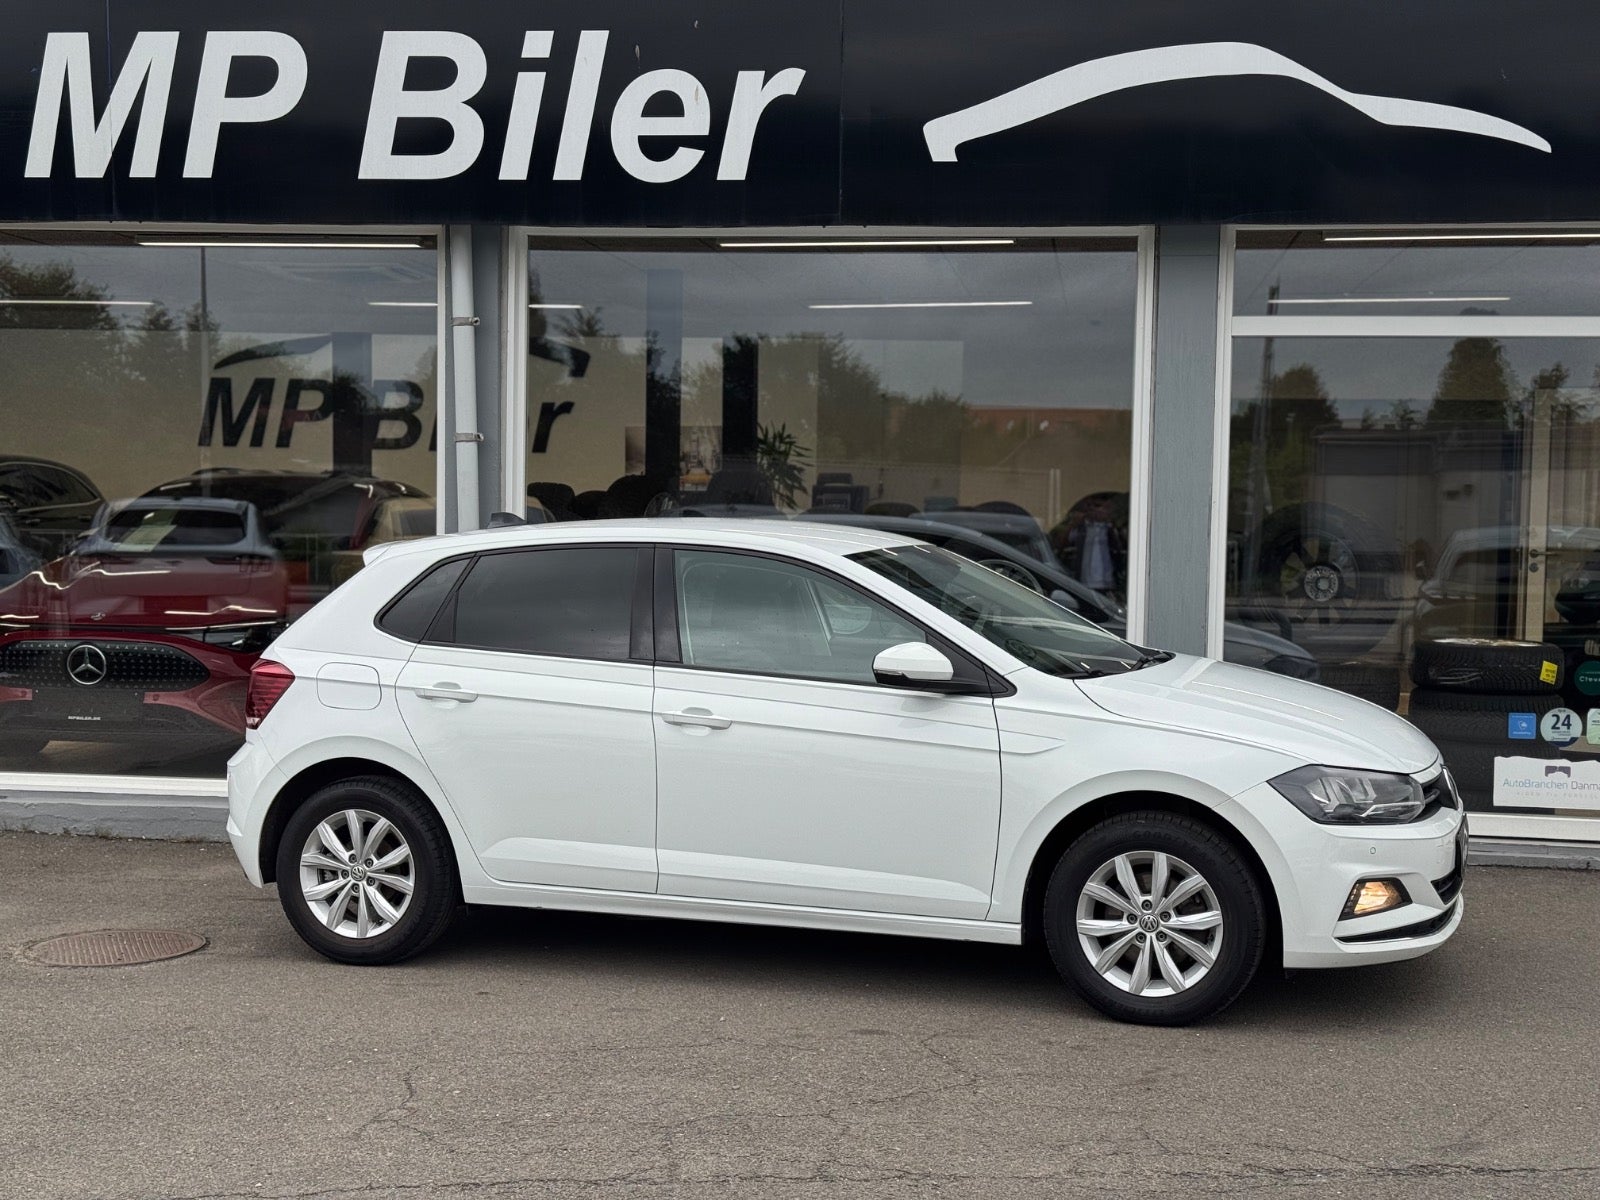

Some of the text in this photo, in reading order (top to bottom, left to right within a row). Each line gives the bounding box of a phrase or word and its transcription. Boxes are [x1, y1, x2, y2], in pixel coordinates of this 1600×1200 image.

[24, 29, 806, 184] MP Biler
[198, 376, 333, 449] MP
[1551, 713, 1572, 731] 24
[1502, 777, 1569, 790] AutoBranchen
